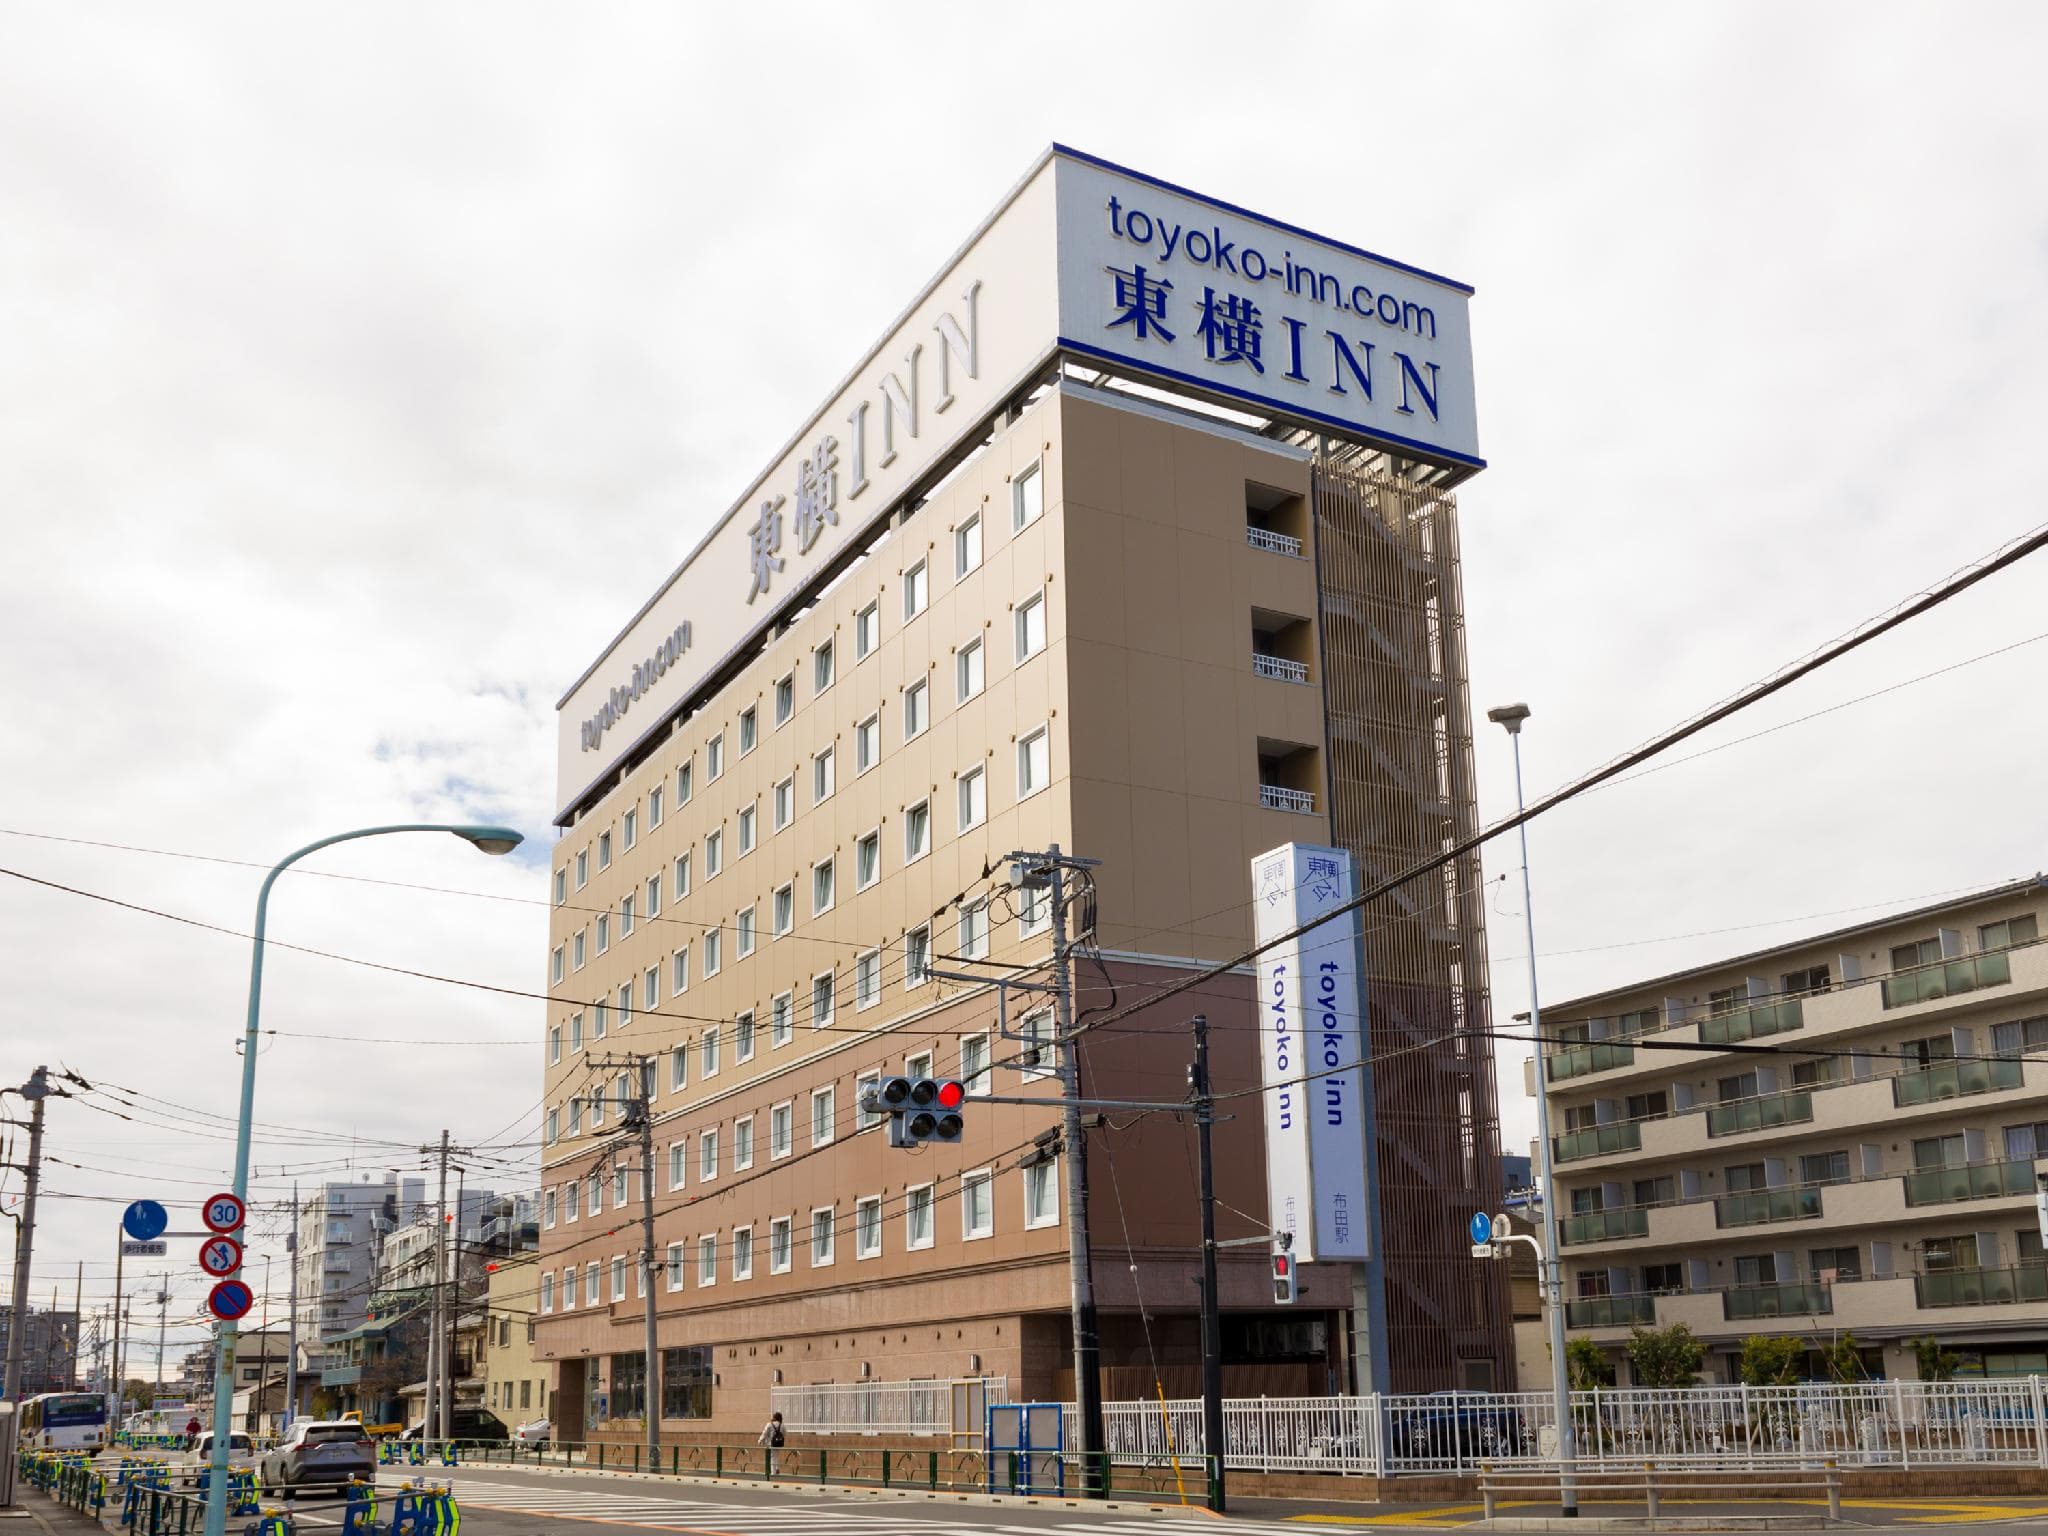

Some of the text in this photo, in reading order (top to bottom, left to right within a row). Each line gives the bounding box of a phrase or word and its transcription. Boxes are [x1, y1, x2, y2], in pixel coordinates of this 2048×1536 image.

[1105, 195, 1437, 339] toyoko-inn.com
[1104, 264, 1441, 424] 東横INN
[1272, 964, 1293, 1130] toyoko inn
[1317, 961, 1346, 1126] toyoko inn
[212, 1204, 238, 1223] 30
[1332, 1192, 1349, 1244] 布田駅
